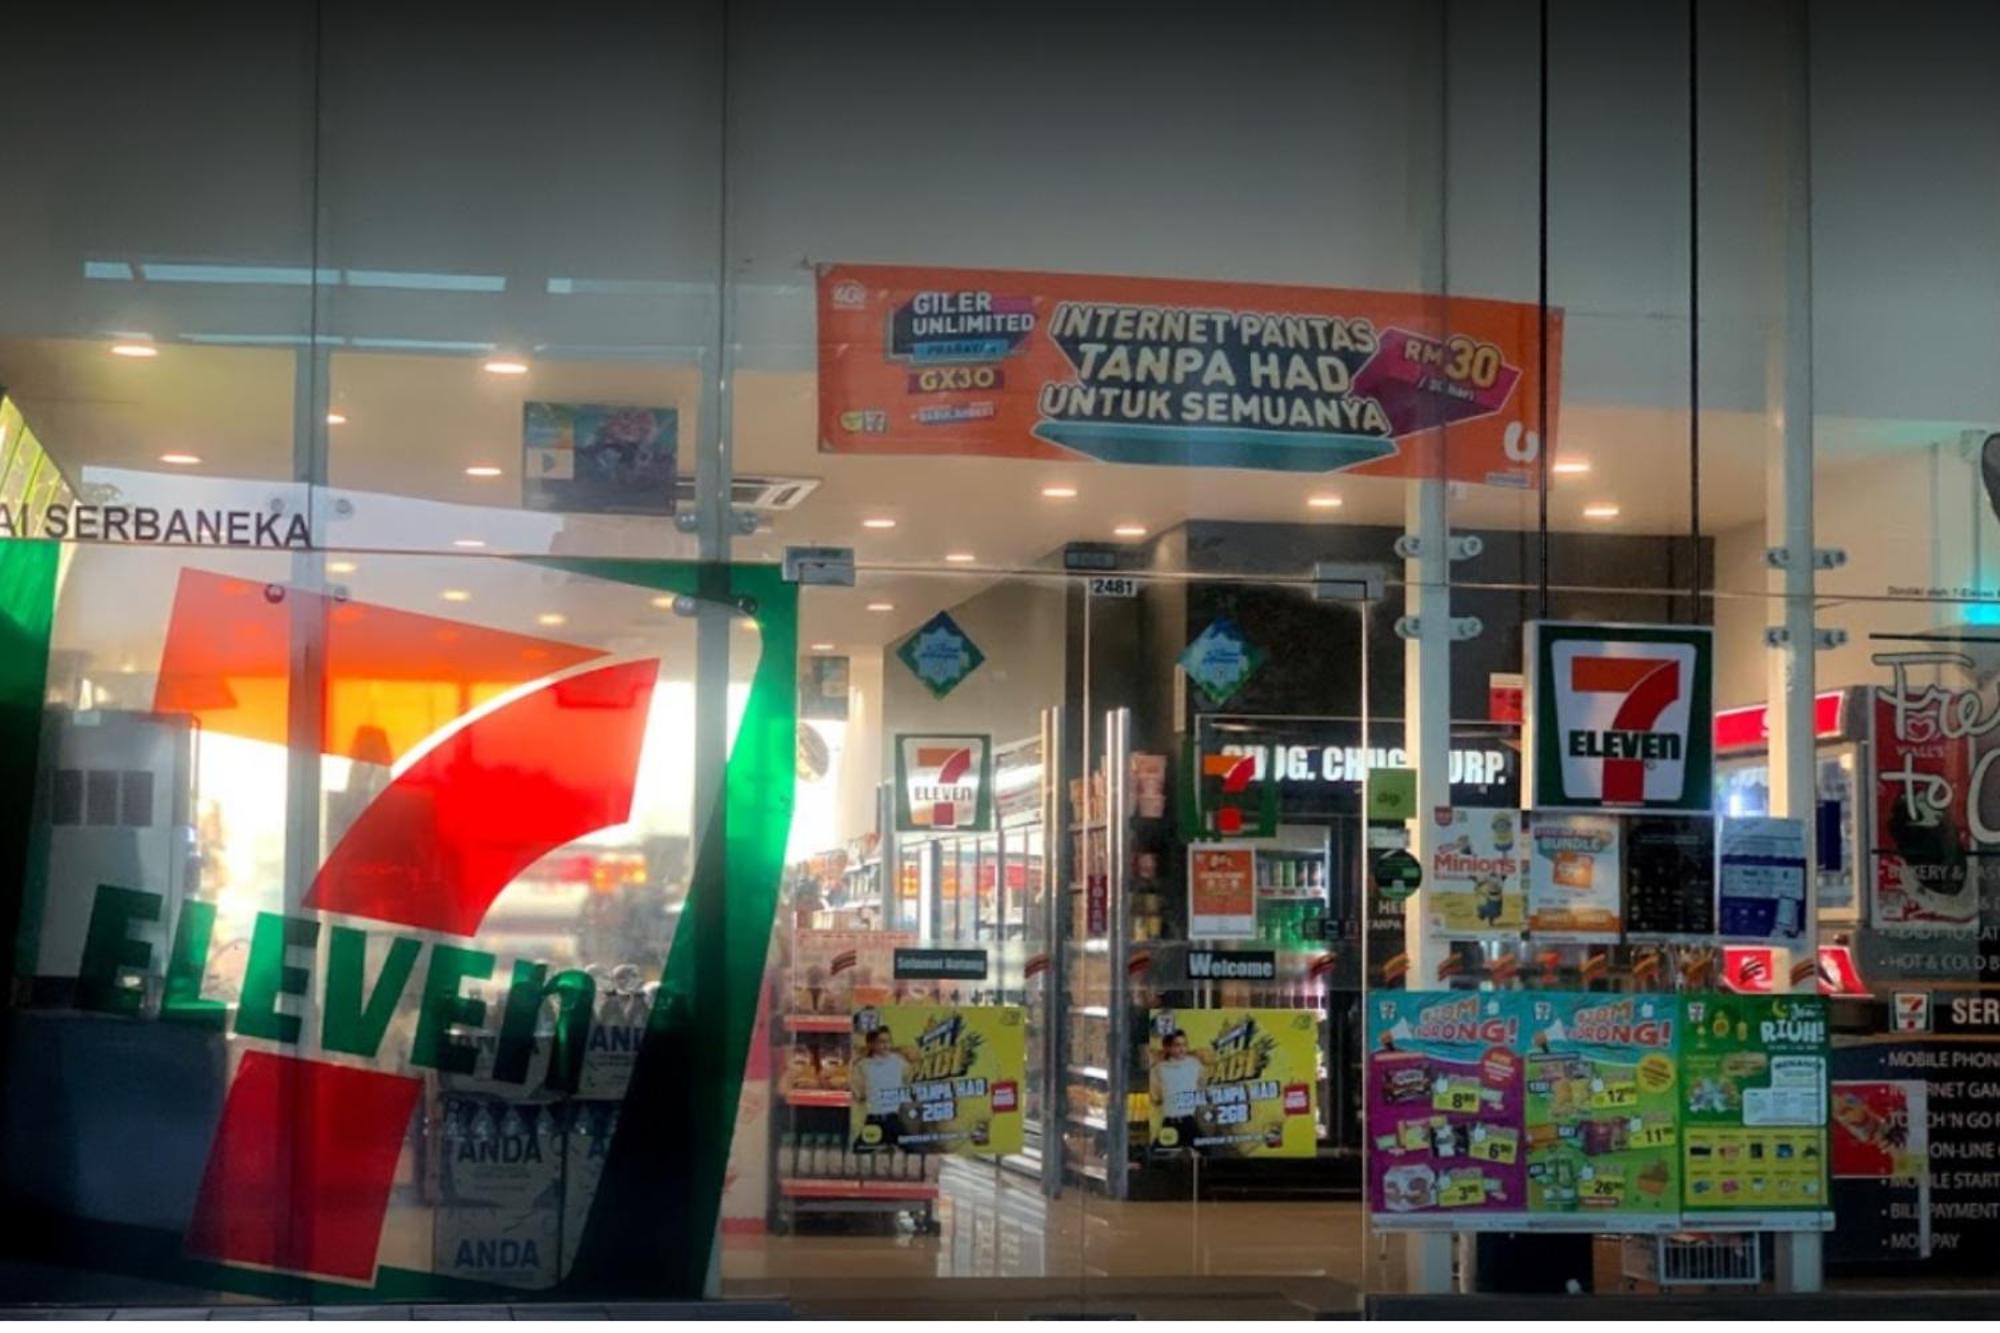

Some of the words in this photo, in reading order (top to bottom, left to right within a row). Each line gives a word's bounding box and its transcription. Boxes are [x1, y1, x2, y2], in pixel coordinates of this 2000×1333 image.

[912, 291, 992, 314] GILER
[911, 313, 1036, 335] UNLIMITED
[1051, 304, 1230, 344] INTERNET
[1241, 316, 1376, 353] PANTAS
[1077, 344, 1236, 388] TANPA
[1249, 352, 1349, 393] HAD
[1041, 384, 1172, 422] UNTUK
[1181, 396, 1387, 433] SEMUANYA
[45, 504, 313, 549] SERBANEKA
[1094, 579, 1133, 594] 2481
[1433, 853, 1516, 874] Minions
[1188, 953, 1273, 977] Welcome
[1888, 1051, 1948, 1068] MOBILE
[1966, 1112, 1993, 1128] GO
[457, 1134, 542, 1164] ANDA
[1890, 1233, 1961, 1249] MOPAY
[453, 1238, 541, 1270] ANDA
